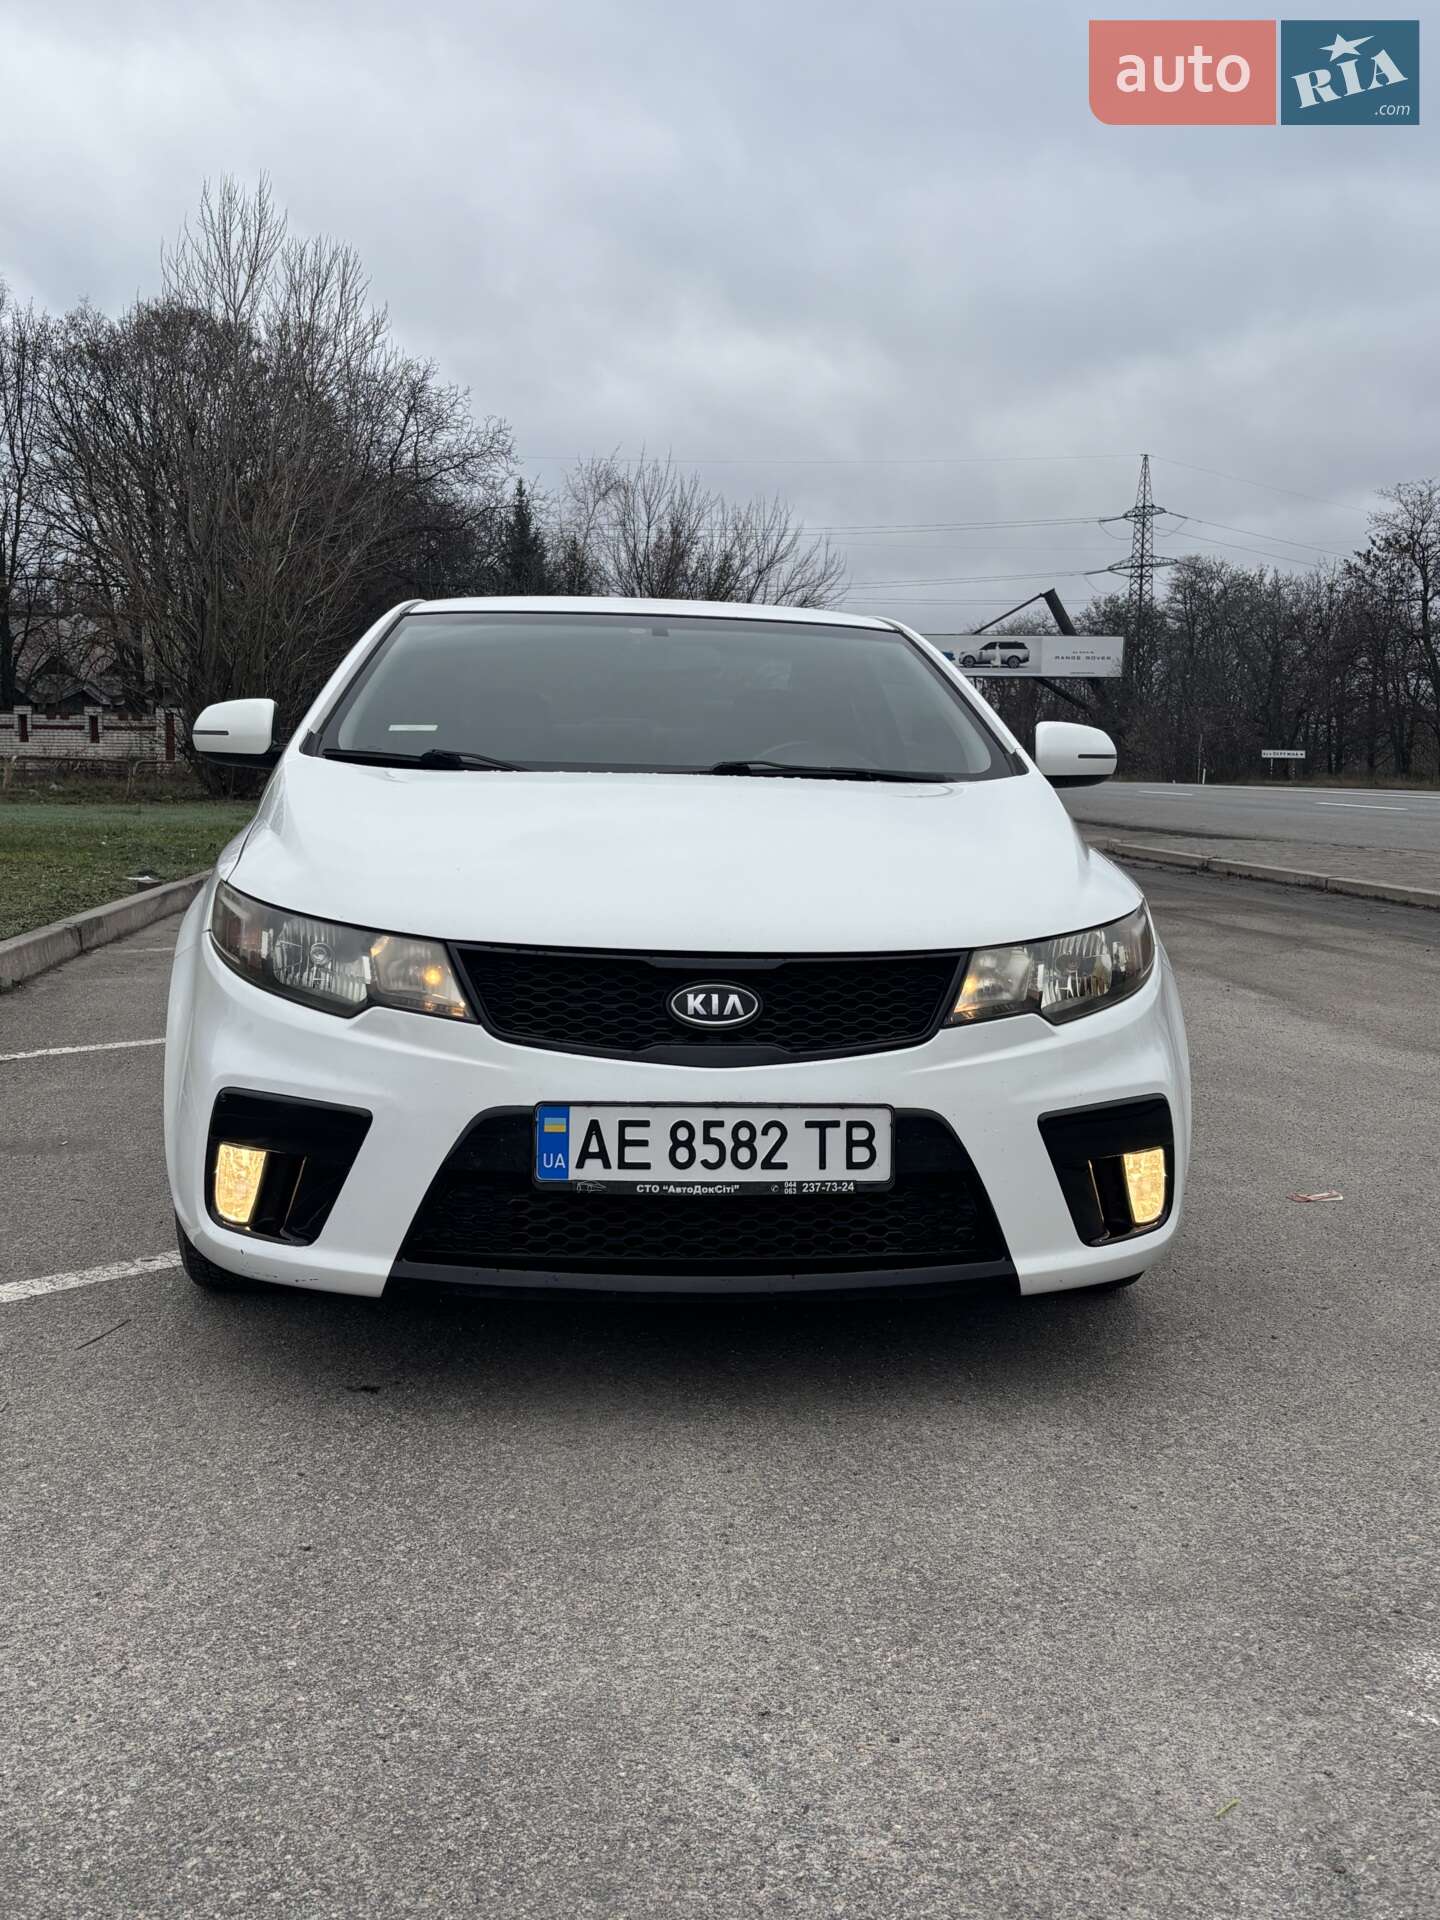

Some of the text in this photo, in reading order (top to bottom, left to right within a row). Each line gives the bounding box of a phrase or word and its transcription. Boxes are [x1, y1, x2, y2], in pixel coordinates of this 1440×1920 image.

[686, 993, 745, 1015] KIA
[543, 1119, 878, 1171] UA AE 8582 TB
[636, 1184, 660, 1193] СТО
[802, 1182, 855, 1193] 237-73-24
